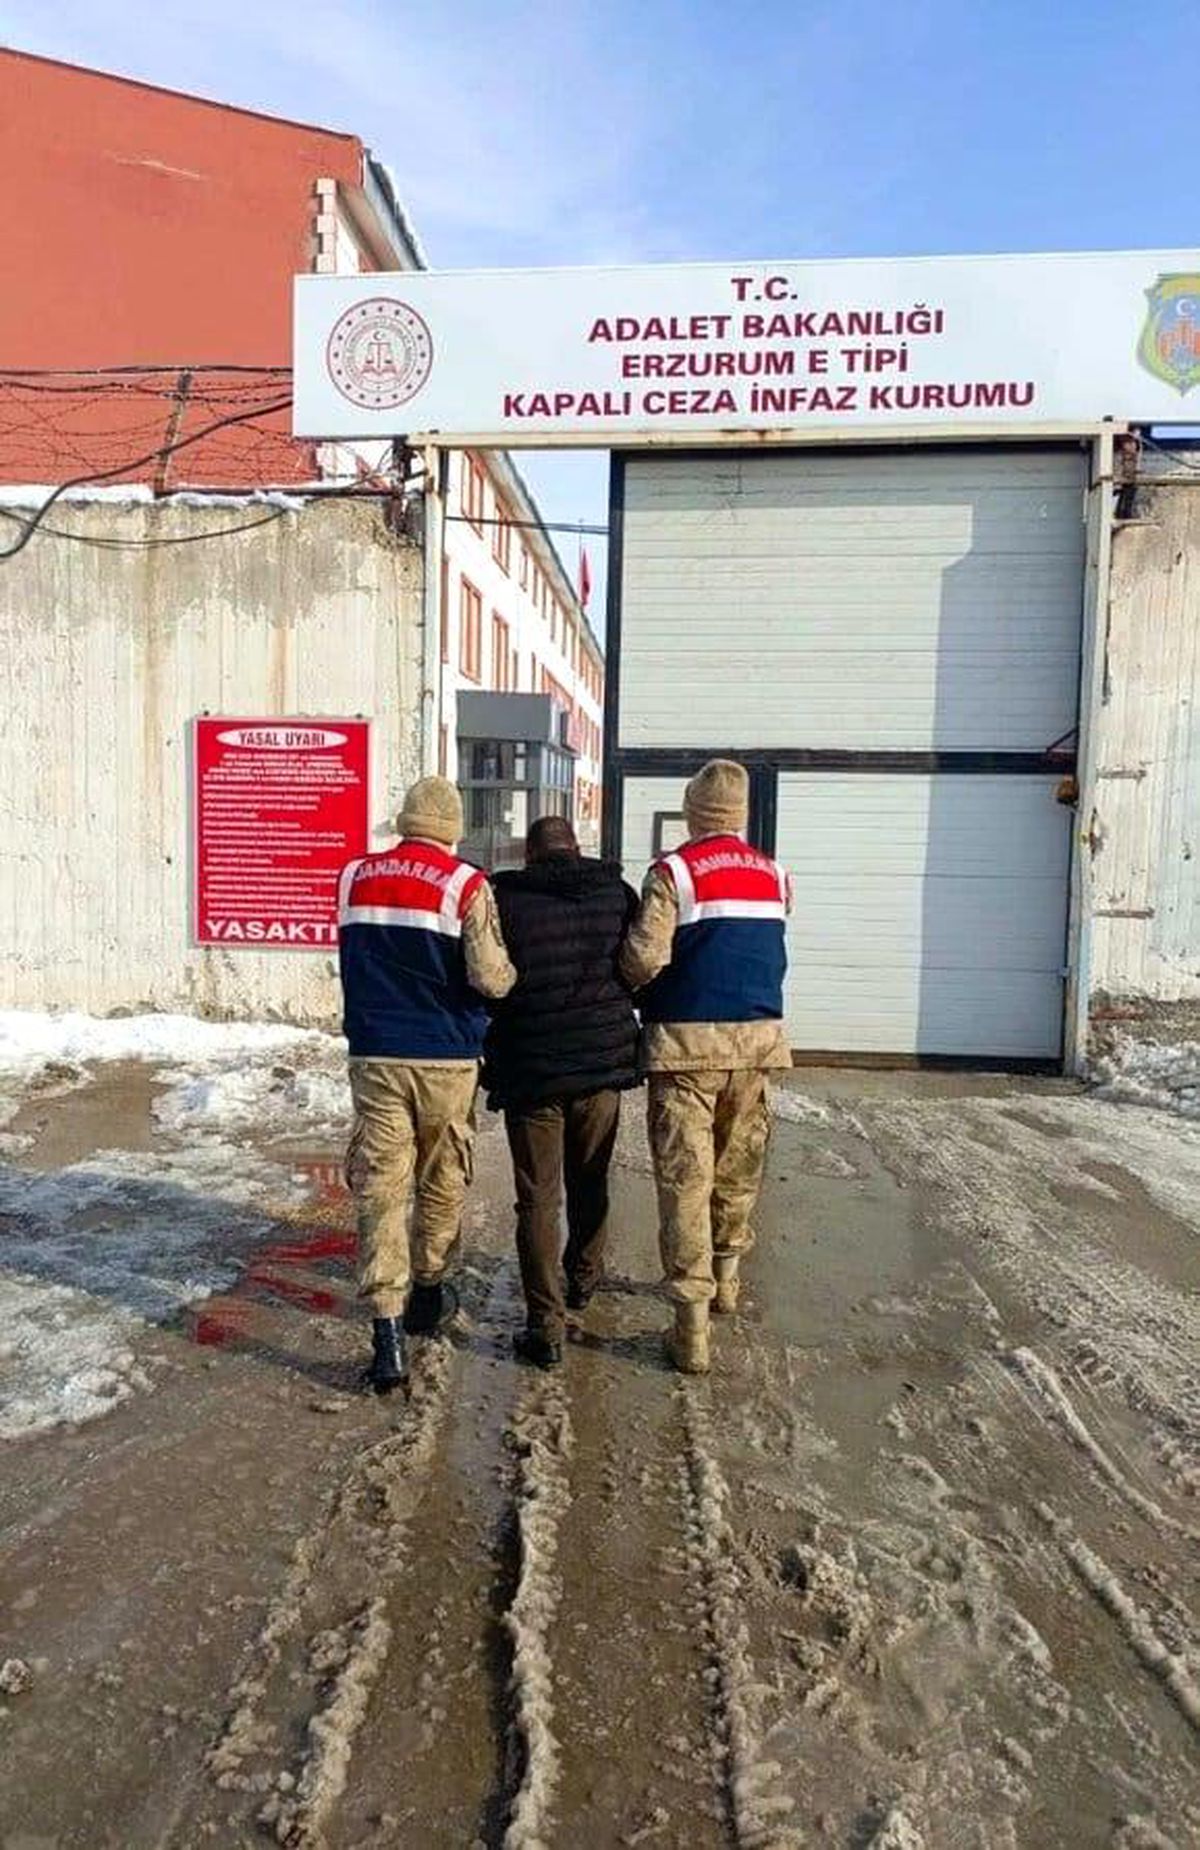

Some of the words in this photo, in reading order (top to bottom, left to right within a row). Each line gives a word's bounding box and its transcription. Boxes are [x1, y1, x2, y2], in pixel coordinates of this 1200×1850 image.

[731, 276, 798, 302] T.C.
[588, 315, 732, 343] ADALET
[742, 303, 944, 339] BAKANLIĞI
[622, 350, 795, 379] ERZURUM
[808, 349, 829, 374] E
[840, 342, 908, 373] TİPİ
[503, 391, 632, 418] KAPALI
[642, 389, 738, 415] CEZA
[750, 382, 858, 413] İNFAZ
[869, 382, 1034, 410] KURUMU
[239, 731, 281, 746] YASAL
[285, 731, 326, 746] UYARI
[354, 857, 449, 890] JANDARMA
[205, 920, 338, 942] YASAKTI
